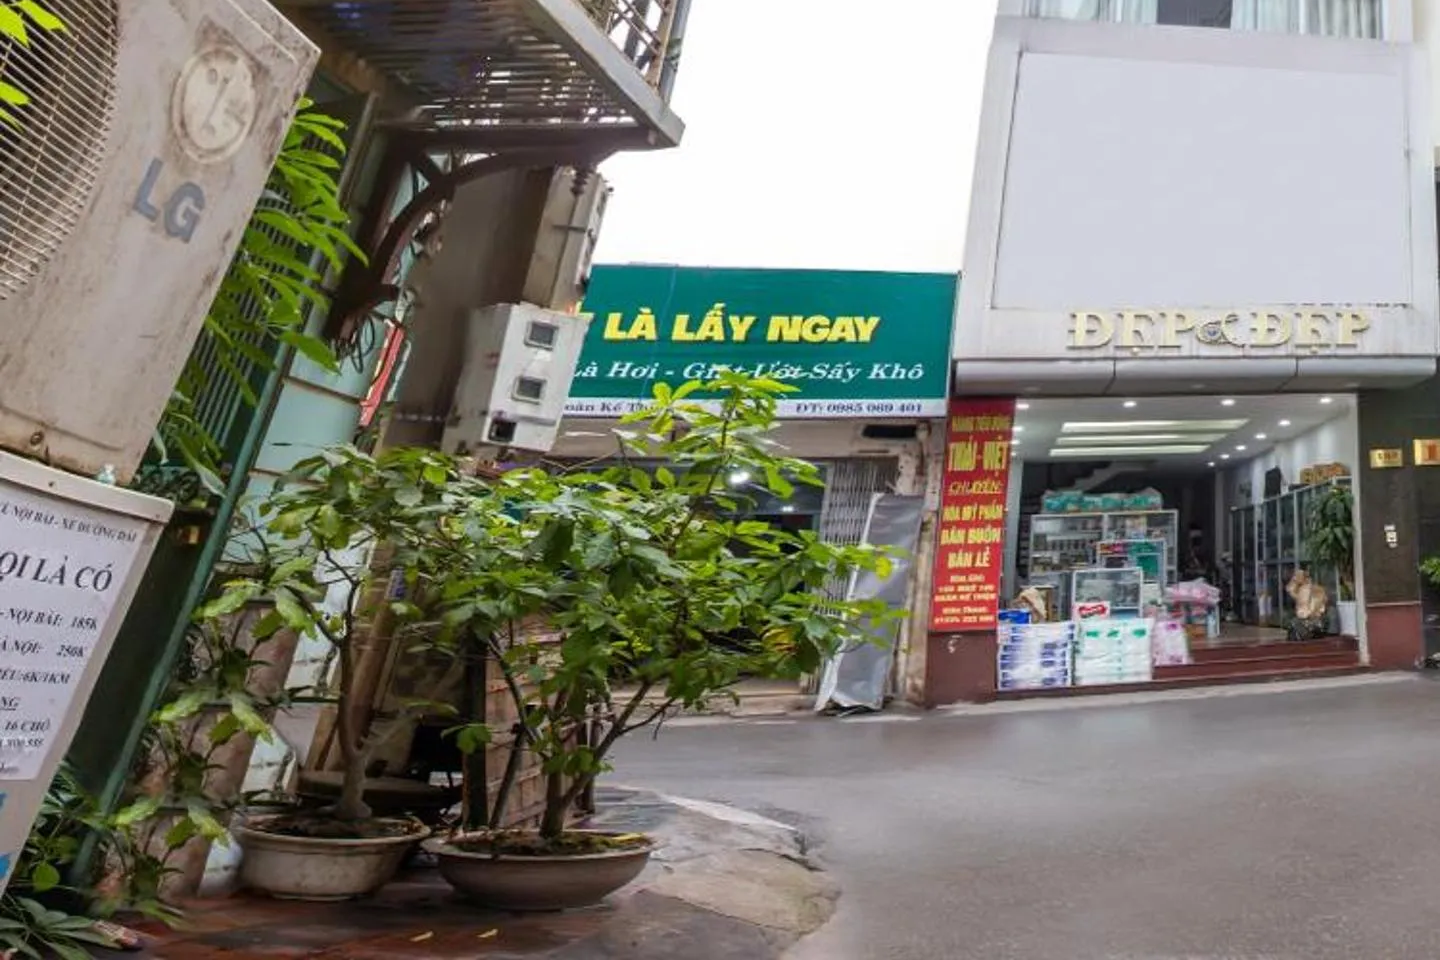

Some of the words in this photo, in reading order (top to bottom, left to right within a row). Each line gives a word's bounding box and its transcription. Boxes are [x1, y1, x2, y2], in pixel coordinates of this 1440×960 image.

[132, 156, 206, 244] LG
[603, 306, 658, 342] LÀ
[671, 302, 757, 343] LẤY
[766, 314, 881, 344] NGAY
[1066, 311, 1198, 356] ĐẸP
[1249, 311, 1371, 356] ĐẸP
[606, 360, 660, 380] Hơi
[810, 359, 863, 384] Sấy
[867, 362, 925, 381] Khô
[32, 554, 69, 586] LÀ
[74, 561, 117, 592] CÓ
